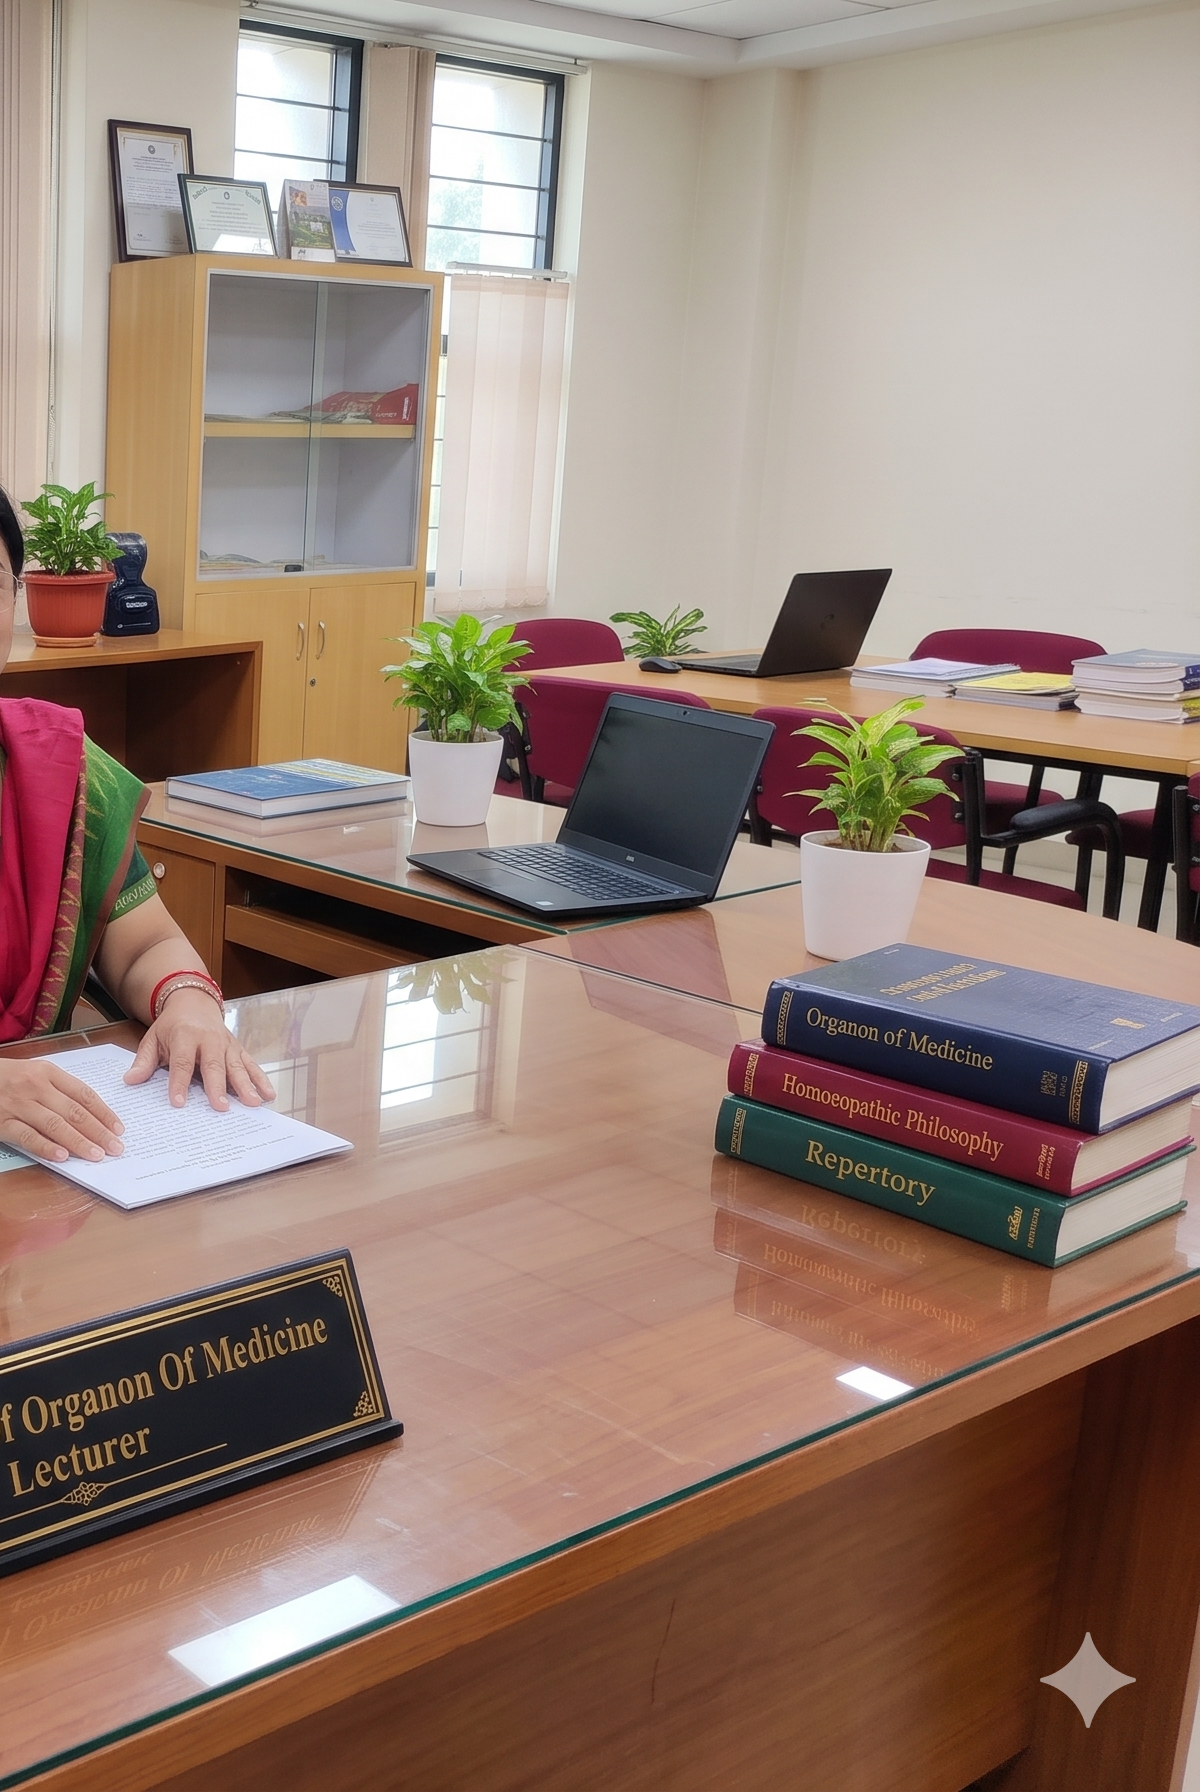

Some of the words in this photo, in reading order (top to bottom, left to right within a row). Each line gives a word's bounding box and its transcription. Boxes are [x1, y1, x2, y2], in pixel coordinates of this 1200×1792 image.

[806, 1007, 879, 1041] Organon
[884, 1029, 907, 1047] of
[907, 1031, 993, 1070] Medicine
[782, 1073, 901, 1126] Homoeopathic
[905, 1109, 1005, 1162] Philosophy
[806, 1140, 936, 1206] Repertory
[21, 1371, 155, 1434] Organon
[159, 1345, 198, 1391] Of
[200, 1318, 329, 1379] Medicine
[8, 1427, 150, 1496] Lecturer
